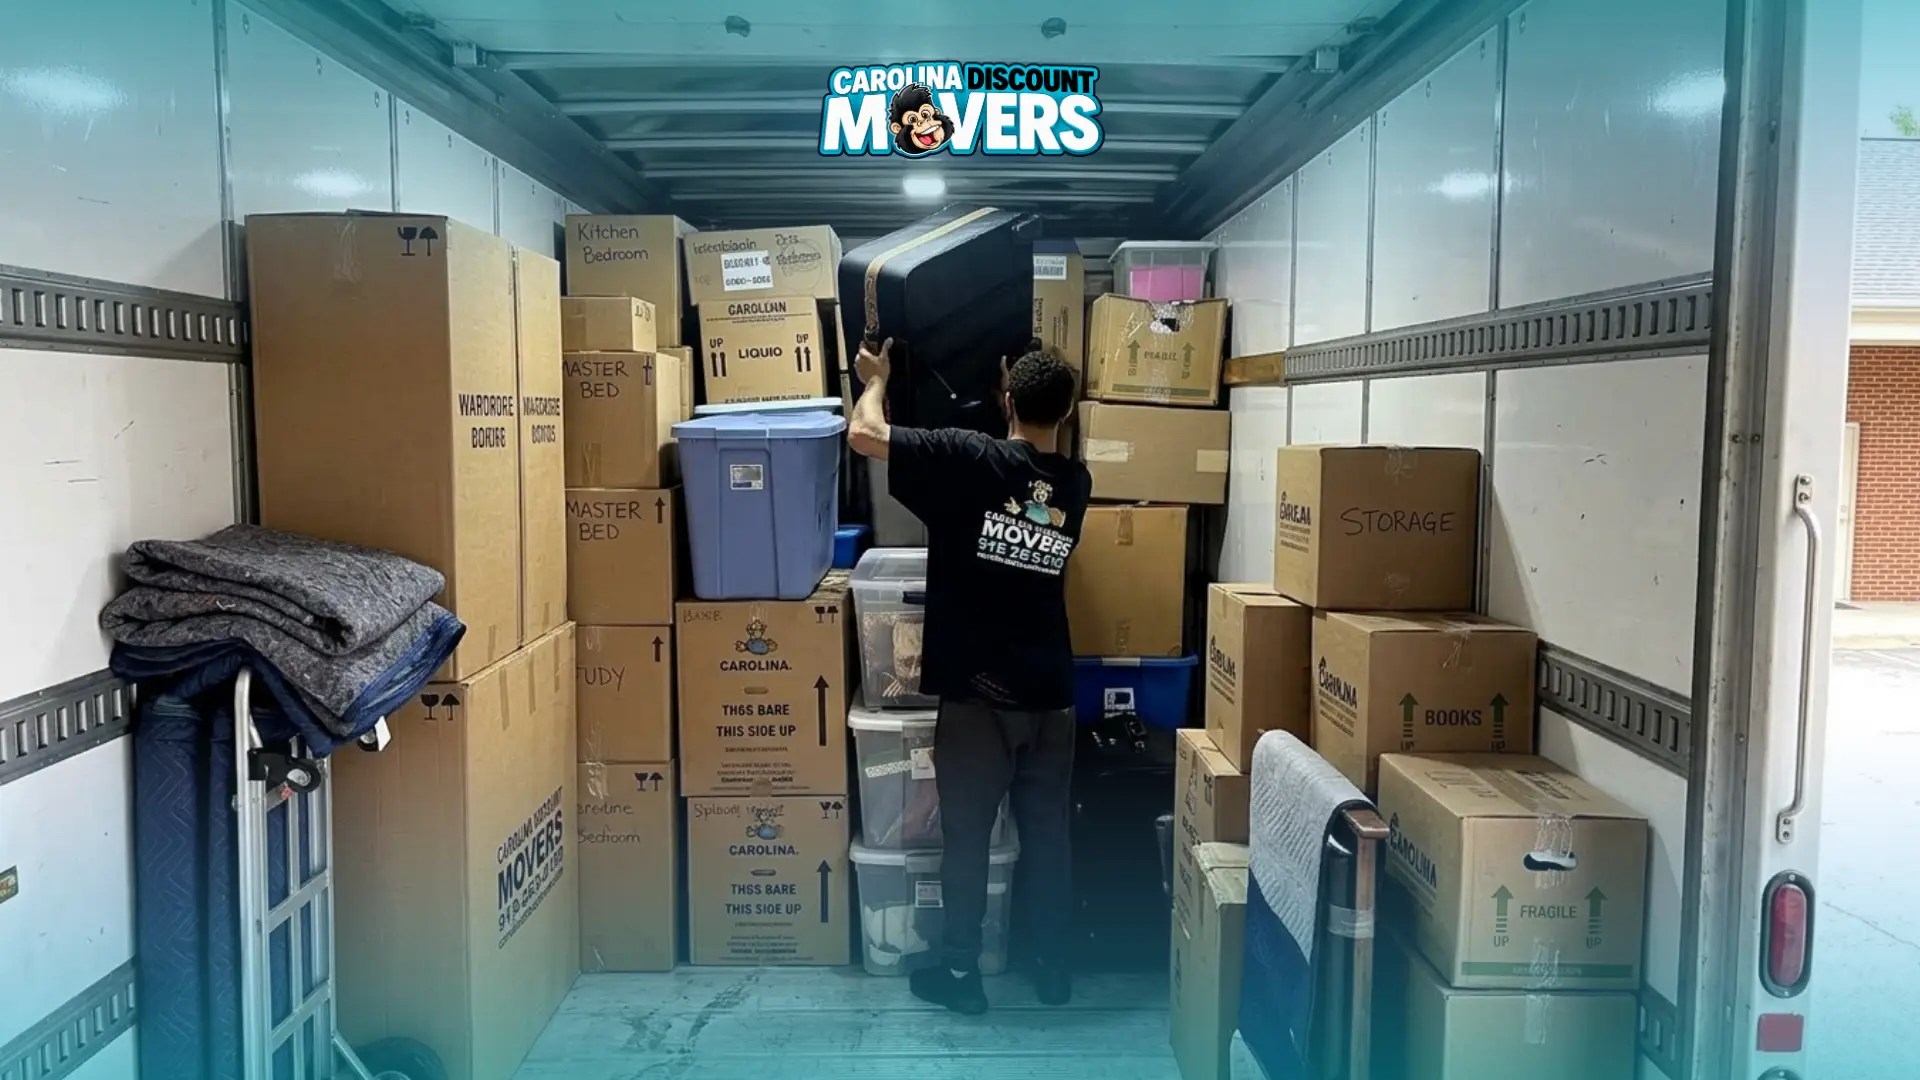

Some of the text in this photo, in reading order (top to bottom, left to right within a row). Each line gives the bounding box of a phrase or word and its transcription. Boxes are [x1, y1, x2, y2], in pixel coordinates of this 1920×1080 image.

[577, 222, 640, 242] Kitchen
[583, 246, 649, 265] Bedroom
[709, 337, 724, 349] UP
[580, 381, 620, 399] BED
[566, 501, 643, 520] MASTER
[1340, 506, 1456, 536] STORAGE
[579, 522, 620, 541] BED
[758, 704, 790, 716] BARE
[1424, 708, 1482, 727] BOOKS
[716, 725, 745, 737] THIS
[779, 725, 796, 737] UP
[498, 808, 563, 911] MOVERS
[765, 883, 797, 895] BARE
[725, 903, 752, 915] THIS
[785, 903, 802, 915] UP
[1519, 904, 1578, 919] FRAGILE
[1493, 935, 1510, 948] UP
[1586, 936, 1602, 949] UP
